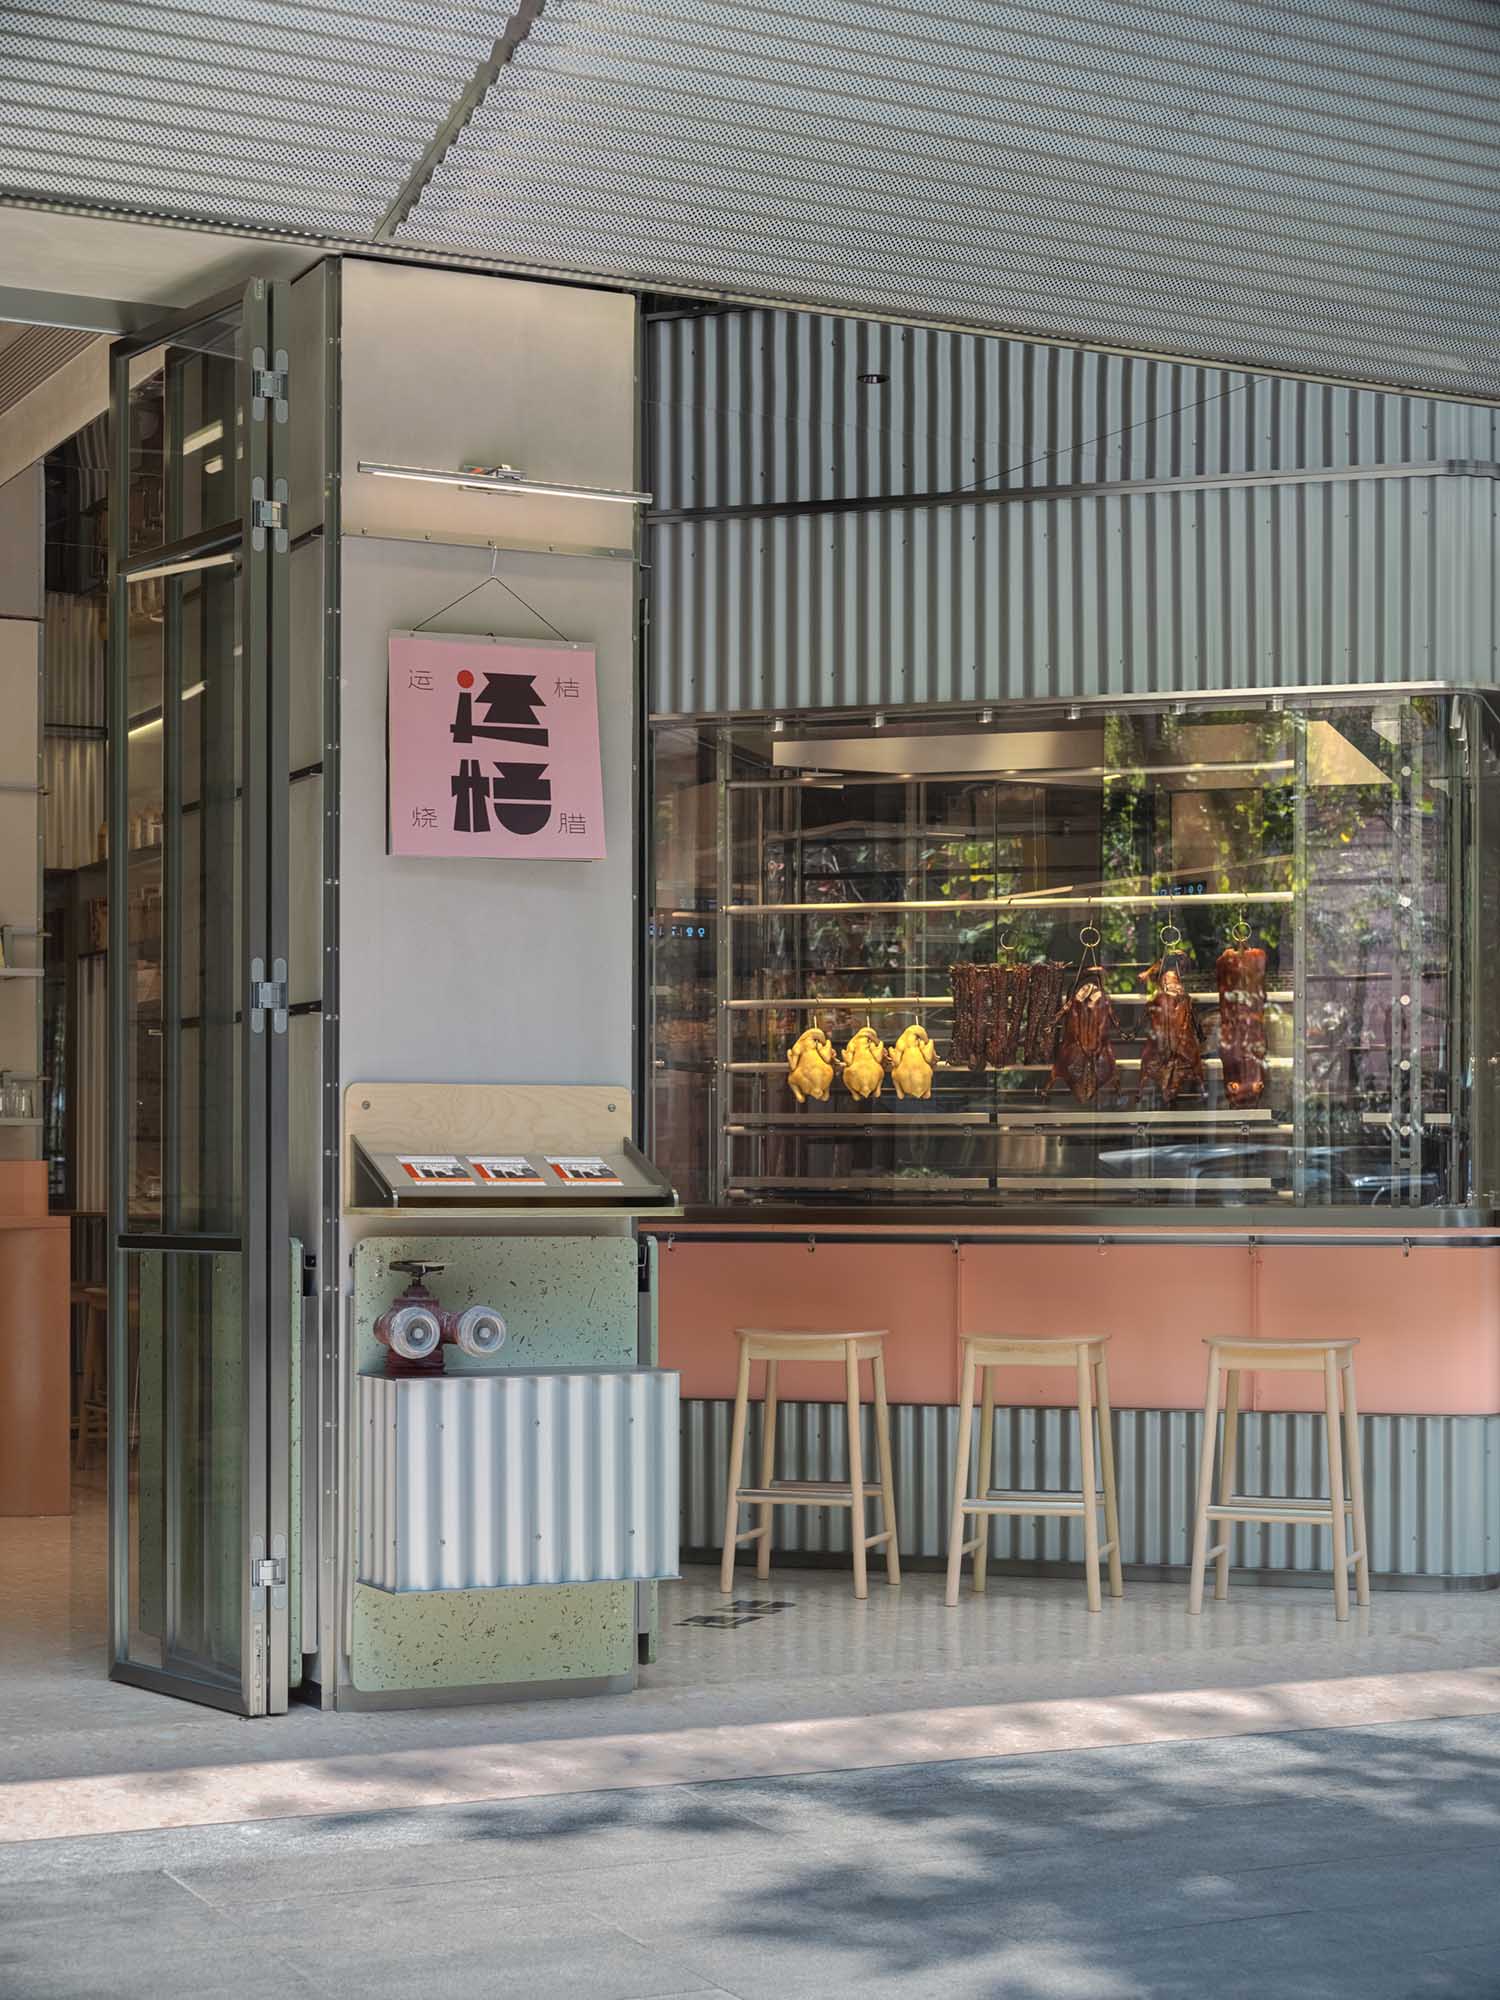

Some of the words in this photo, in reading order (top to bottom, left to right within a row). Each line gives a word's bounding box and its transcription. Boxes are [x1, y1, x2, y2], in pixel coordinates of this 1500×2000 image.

[408, 669, 434, 691] 运
[553, 677, 580, 698] 桔
[412, 806, 439, 828] 烧
[558, 812, 586, 834] 腊
